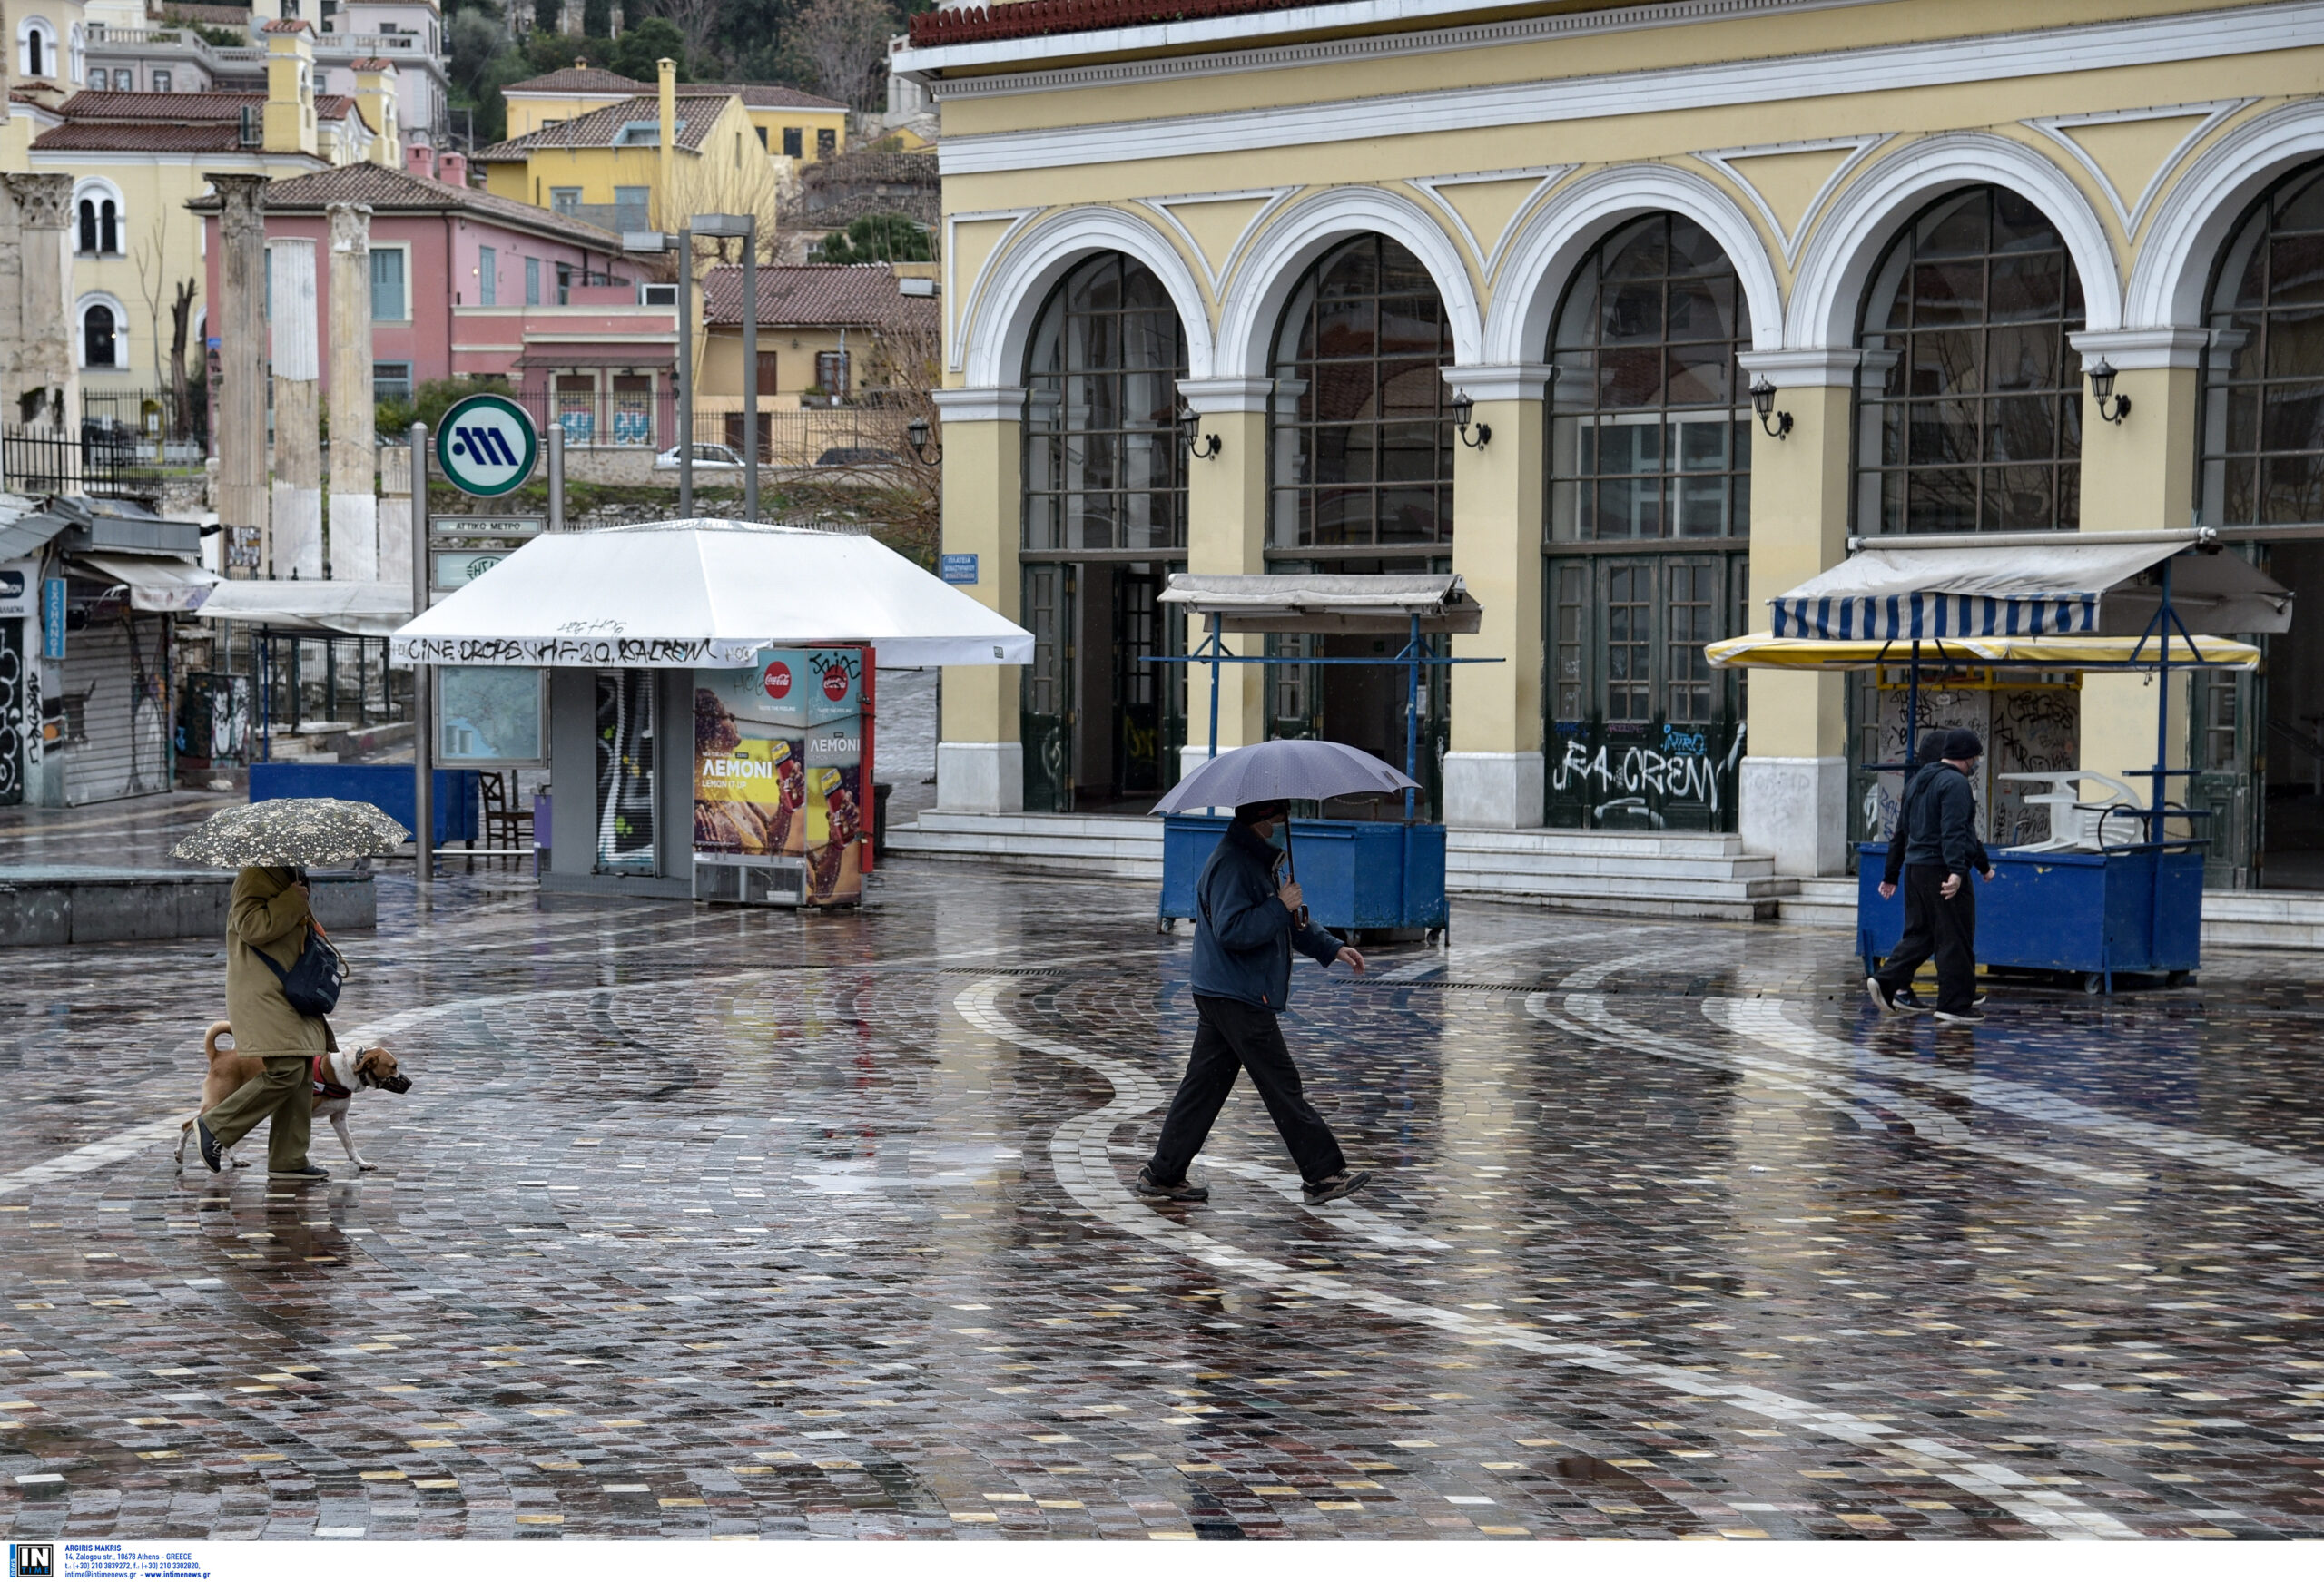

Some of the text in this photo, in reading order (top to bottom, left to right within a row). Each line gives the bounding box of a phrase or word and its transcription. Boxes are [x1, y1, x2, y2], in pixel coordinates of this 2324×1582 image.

[50, 582, 59, 657] EXCHANGE
[764, 673, 790, 686] Coca-Cola
[702, 779, 727, 788] LEMON
[736, 781, 747, 789] UP
